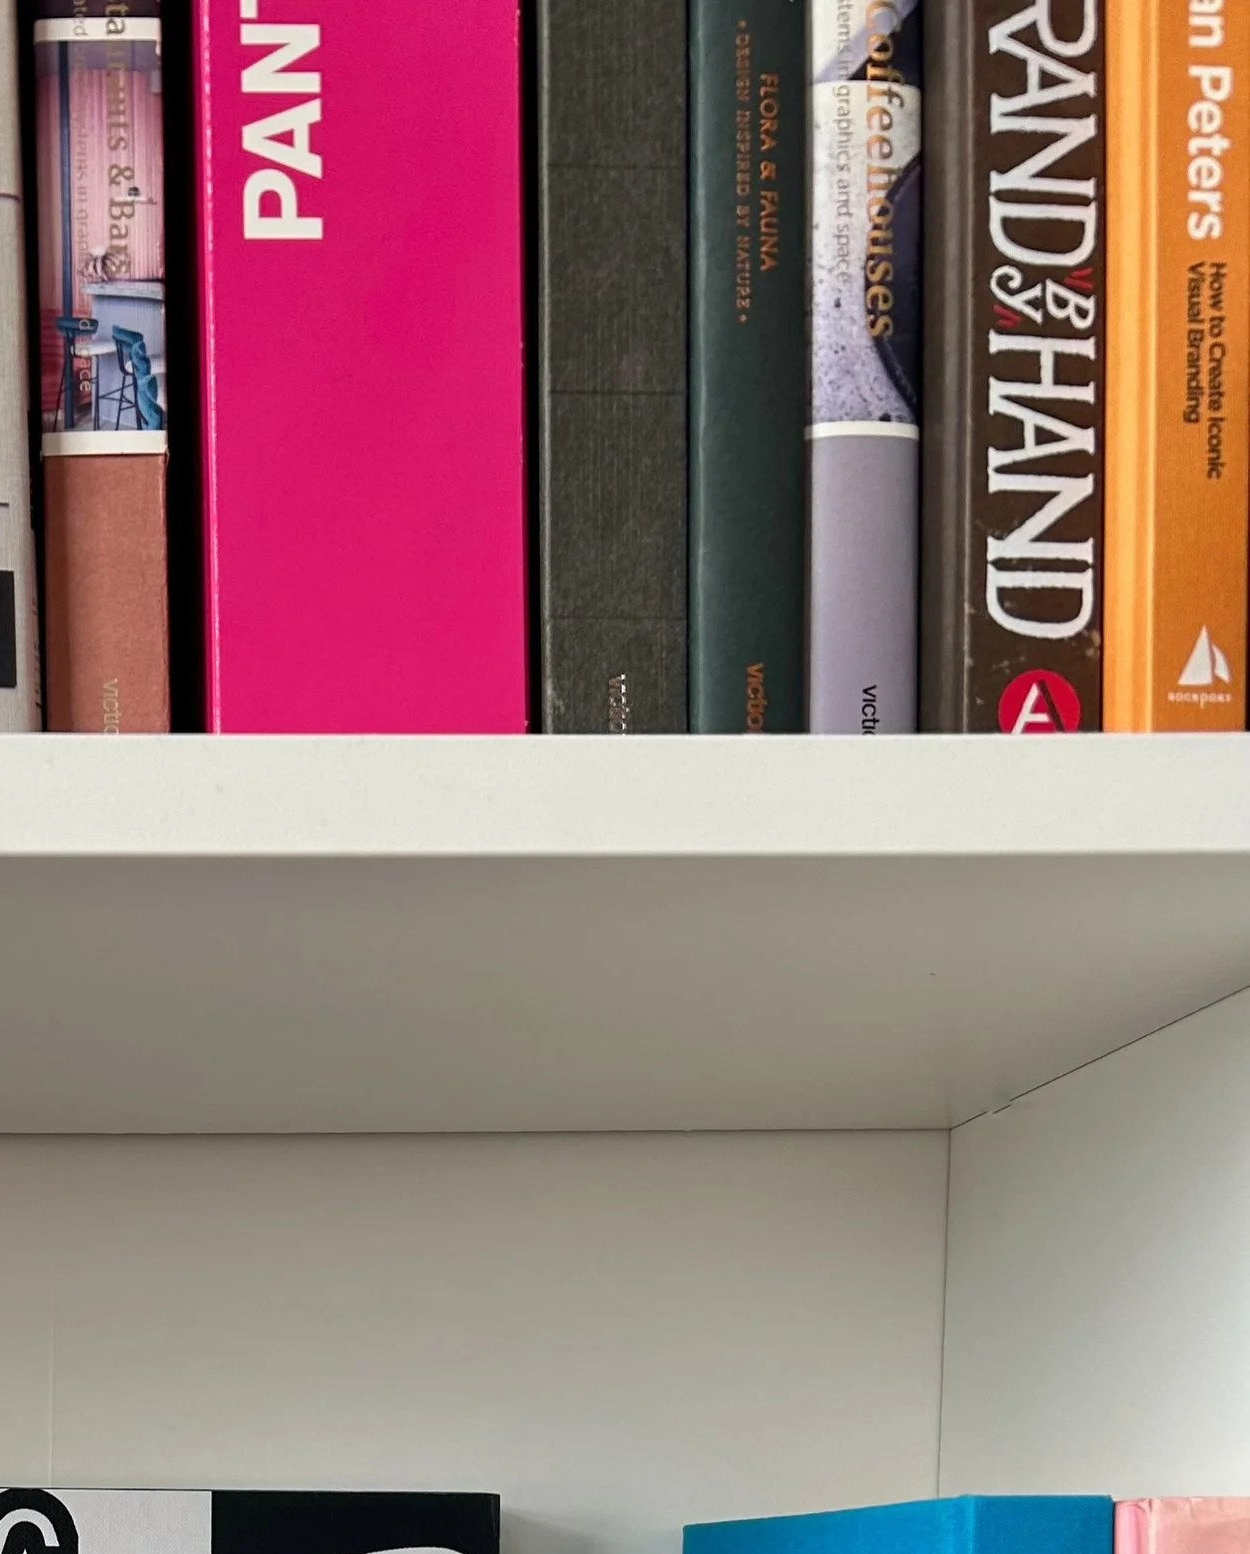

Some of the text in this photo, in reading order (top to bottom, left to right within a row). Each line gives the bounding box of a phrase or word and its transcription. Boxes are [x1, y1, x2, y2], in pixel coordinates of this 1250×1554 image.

[240, 0, 324, 240] PAN
[735, 33, 751, 309] DESIGN INSPIRED BY NATURE
[759, 73, 779, 271] FLORA & FAUNA
[829, 85, 856, 282] graphics and space
[865, 0, 906, 337] Coffeehouses
[1188, 65, 1233, 239] Peters
[1183, 261, 1205, 424] Visual Branding
[1207, 262, 1227, 480] How to Create Iconic
[987, 328, 1095, 640] HAND
